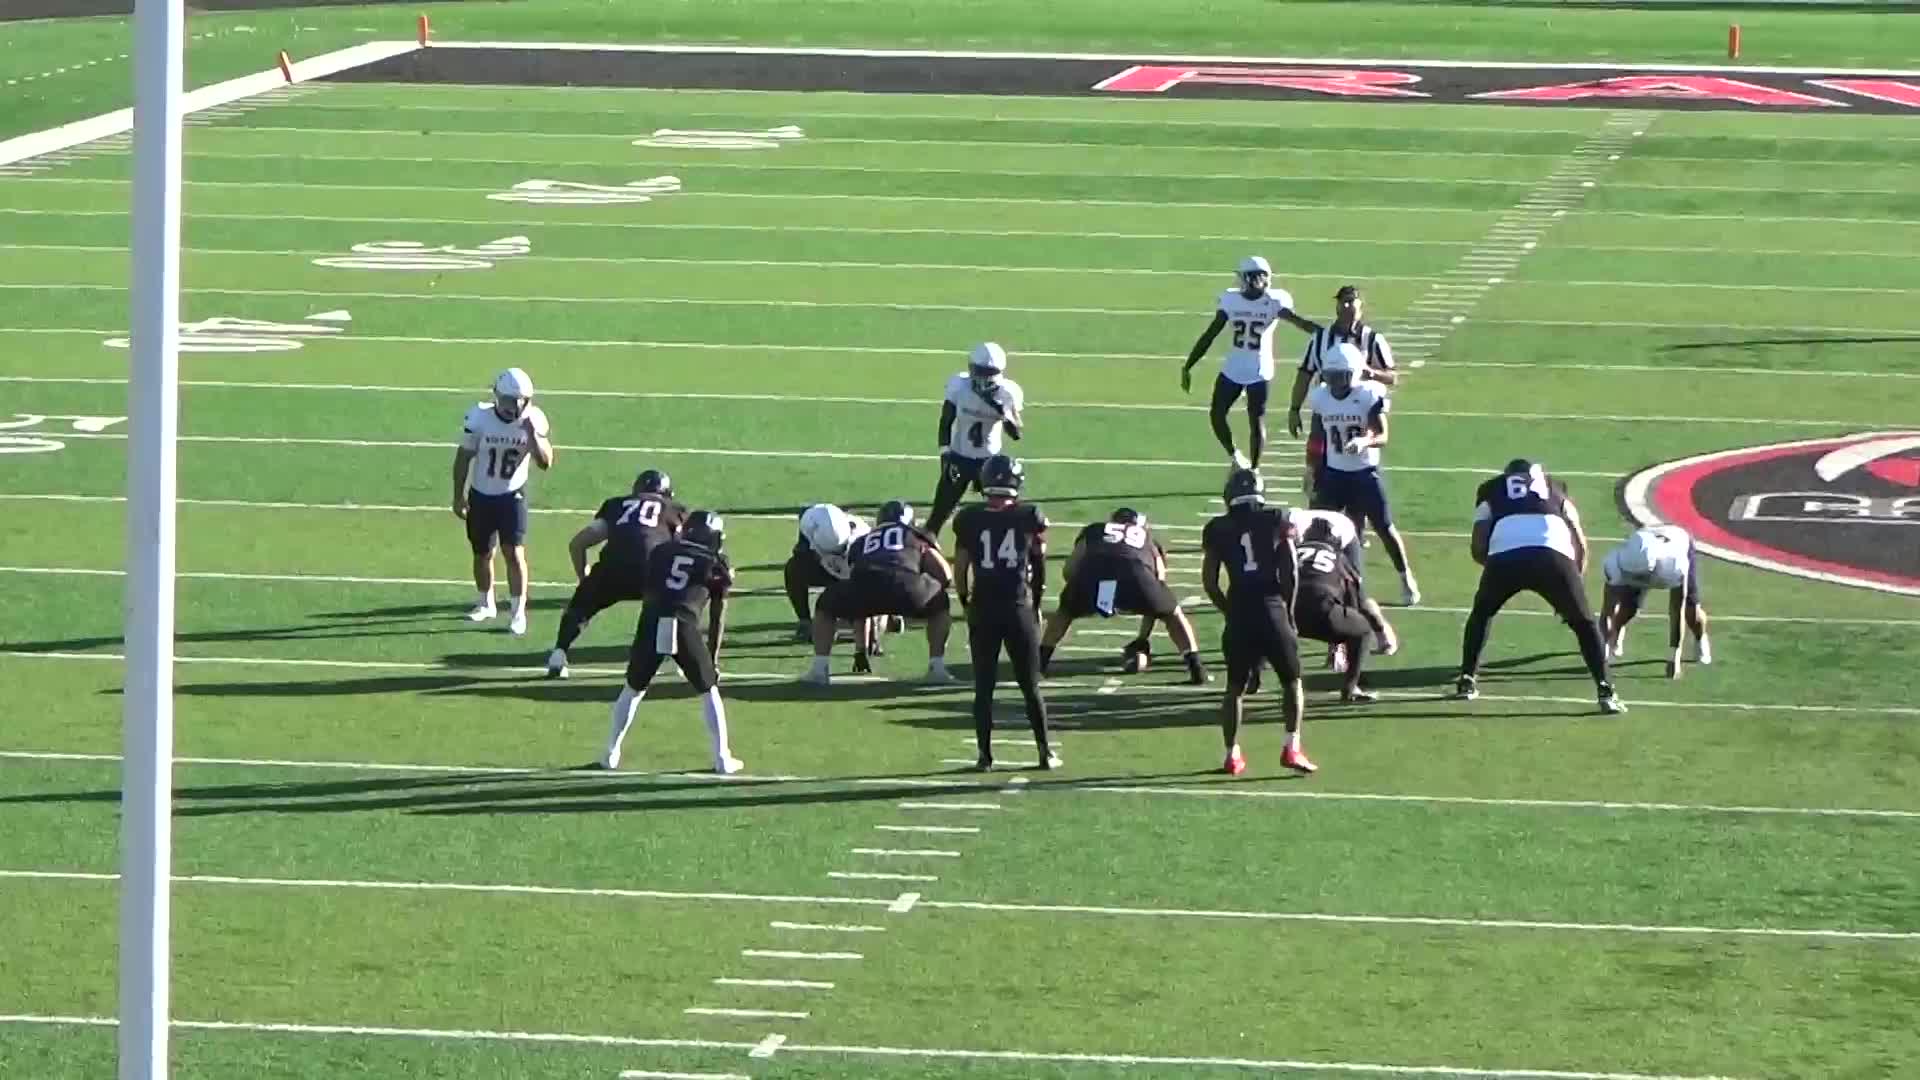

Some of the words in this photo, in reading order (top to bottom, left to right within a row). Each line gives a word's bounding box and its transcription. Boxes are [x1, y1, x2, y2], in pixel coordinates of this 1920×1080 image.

[1233, 320, 1264, 350] 25
[968, 421, 983, 448] 4
[488, 448, 521, 480] 16
[1506, 464, 1550, 500] 64
[616, 499, 662, 527] 70
[863, 527, 904, 554] 60
[980, 529, 1018, 569] 14
[1240, 532, 1258, 572] 1
[665, 555, 694, 590] 5
[1297, 547, 1337, 573] 75
